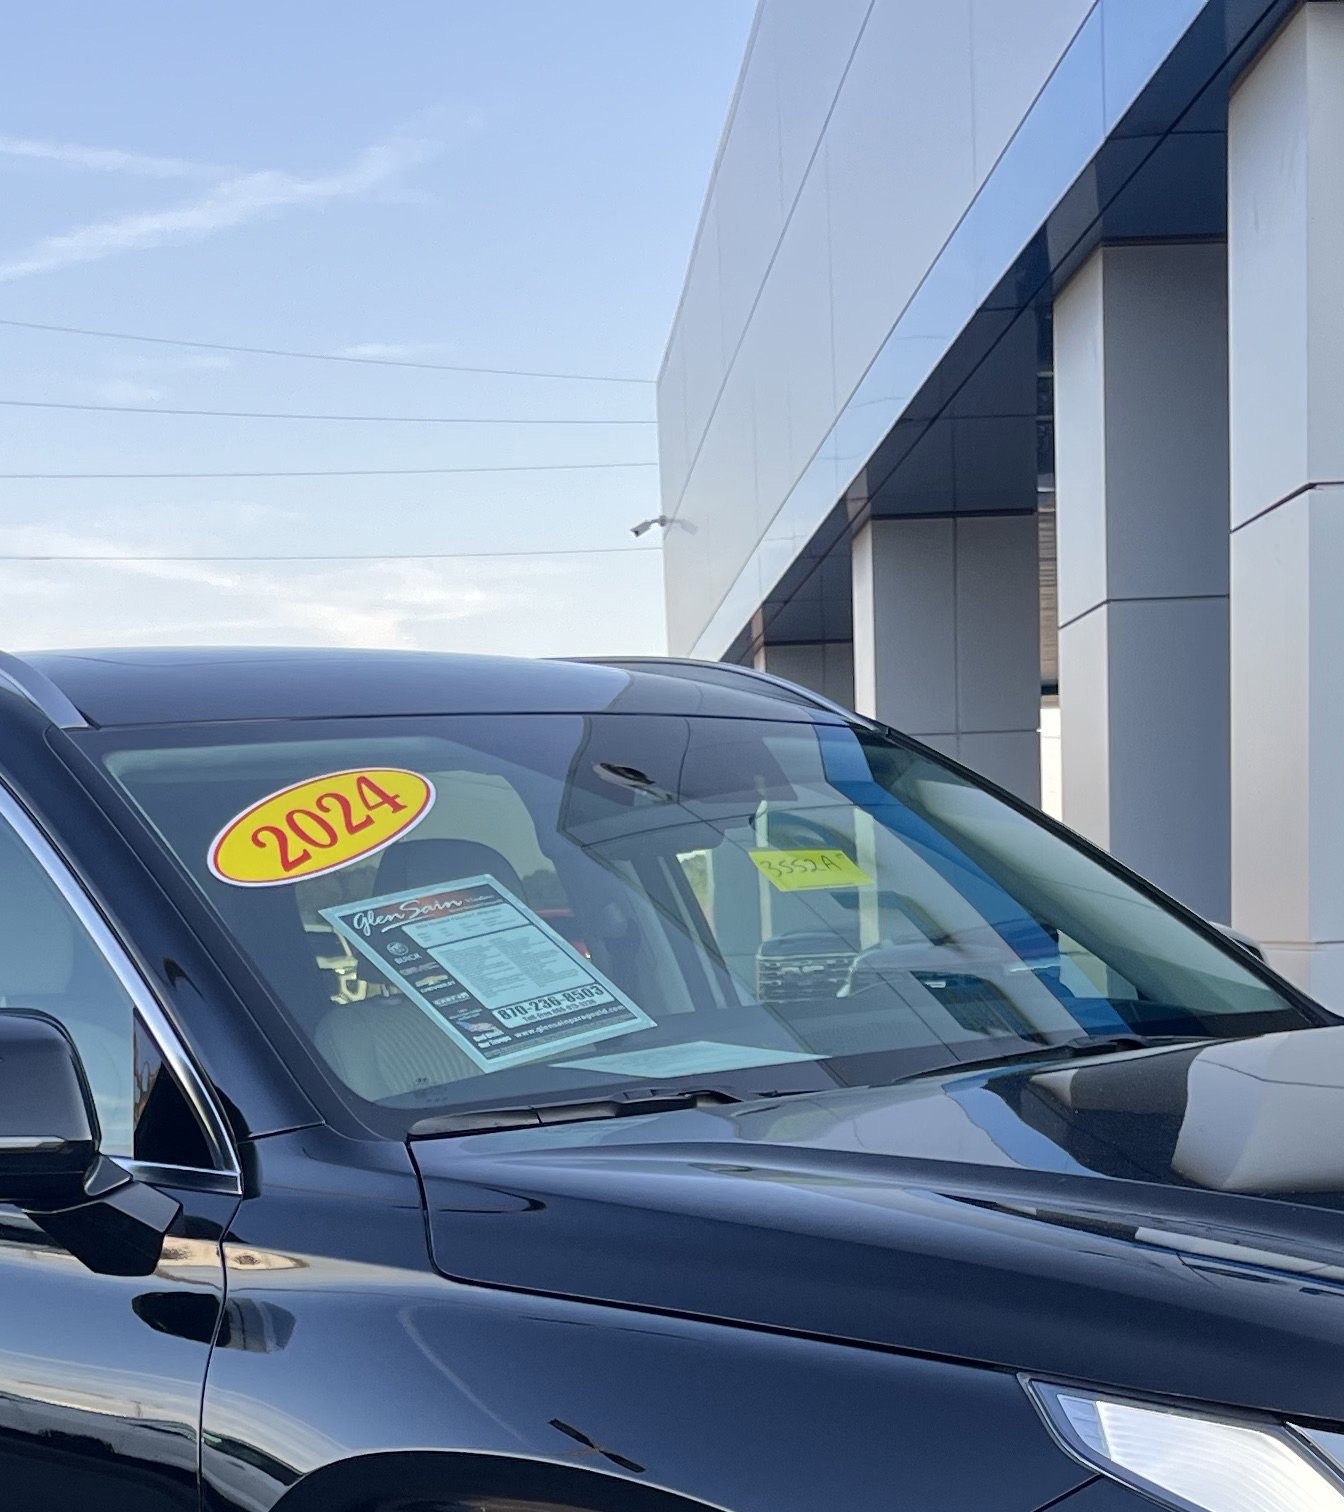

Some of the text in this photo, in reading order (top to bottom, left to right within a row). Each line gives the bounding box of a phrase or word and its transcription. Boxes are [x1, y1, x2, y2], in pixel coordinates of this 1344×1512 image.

[251, 775, 408, 873] 2024
[759, 855, 843, 878] 3552A
[353, 909, 405, 937] Glen
[399, 899, 463, 920] Sain
[497, 985, 605, 1021] 870-236-8503
